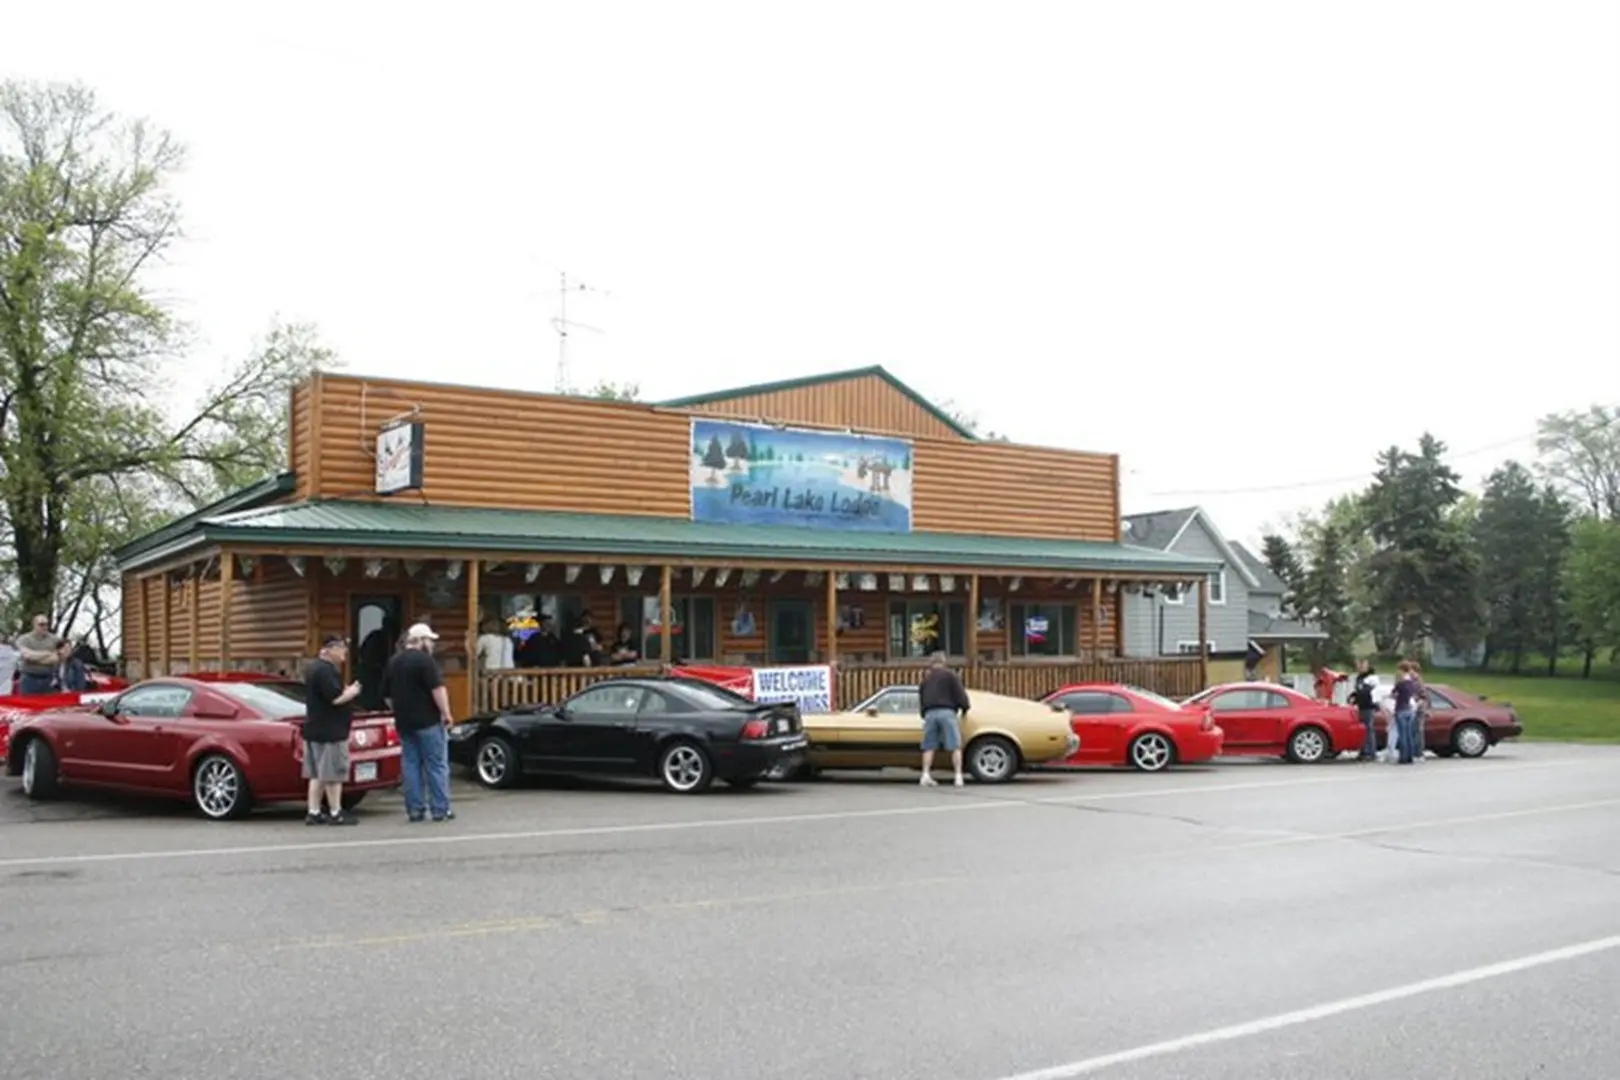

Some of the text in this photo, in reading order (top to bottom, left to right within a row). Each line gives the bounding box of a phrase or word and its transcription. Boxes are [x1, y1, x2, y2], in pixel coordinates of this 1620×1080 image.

[730, 483, 881, 518] Pearl Lake Lodge
[758, 671, 827, 692] WELCOME
